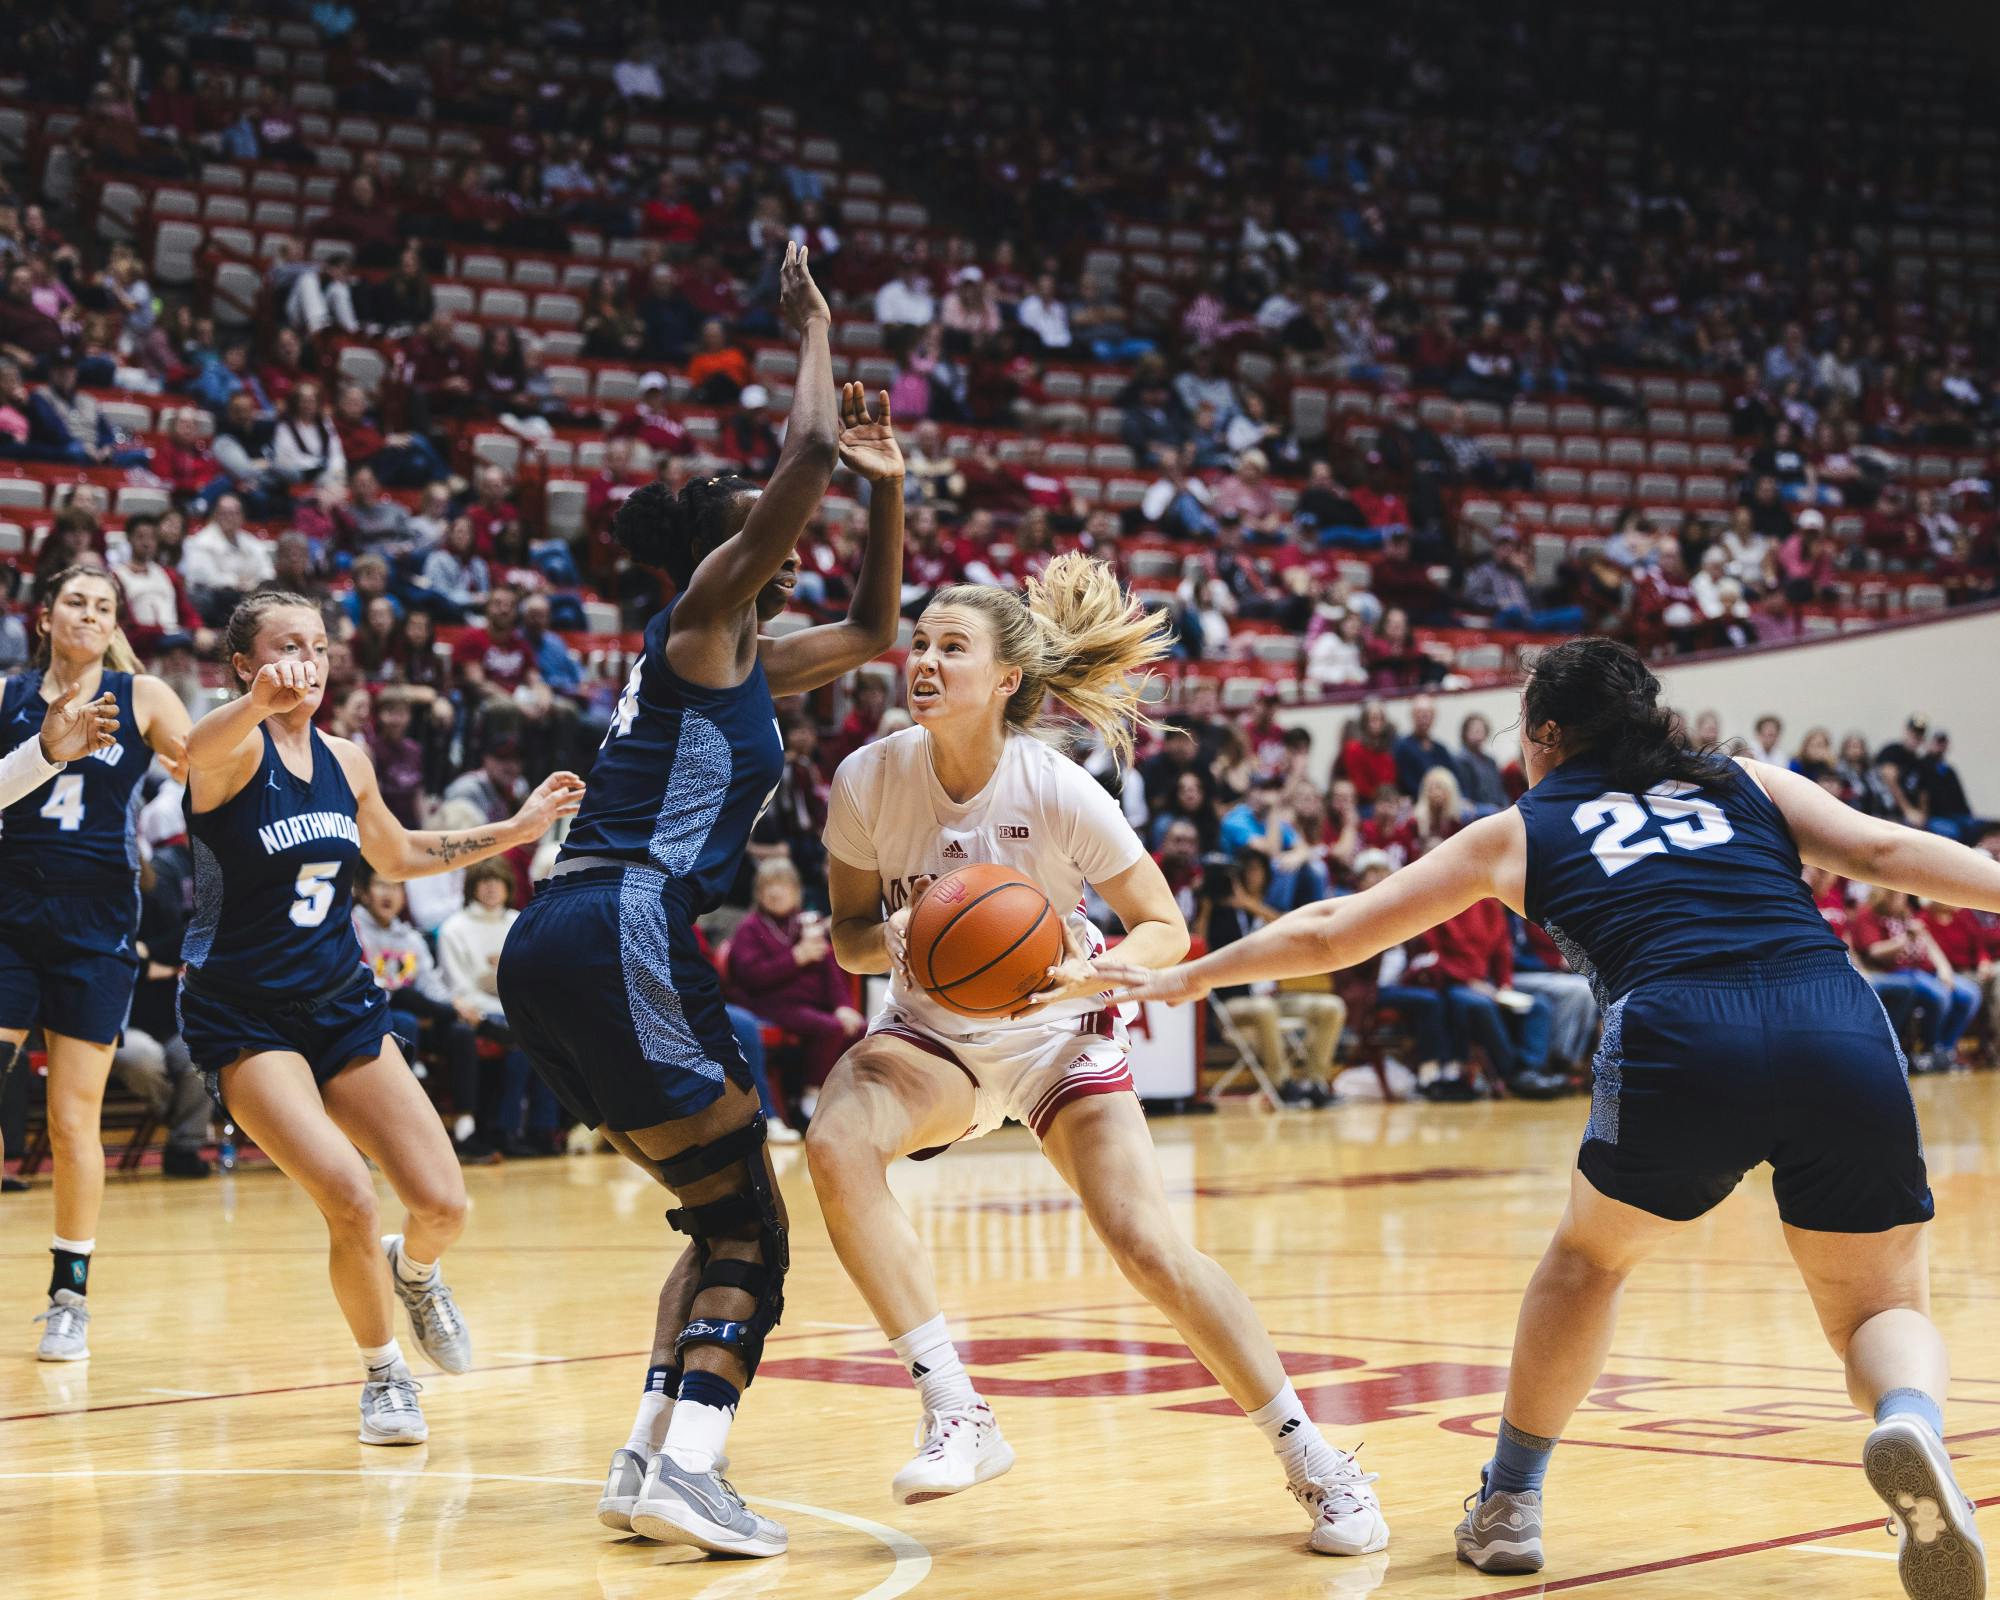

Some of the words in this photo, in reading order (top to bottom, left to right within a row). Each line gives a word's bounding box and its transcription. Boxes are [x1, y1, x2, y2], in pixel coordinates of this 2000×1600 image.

[40, 773, 85, 831] 4
[1571, 779, 1735, 878] 25
[942, 851, 969, 859] adidas
[288, 860, 343, 928] 5
[1069, 1061, 1099, 1069] adidas
